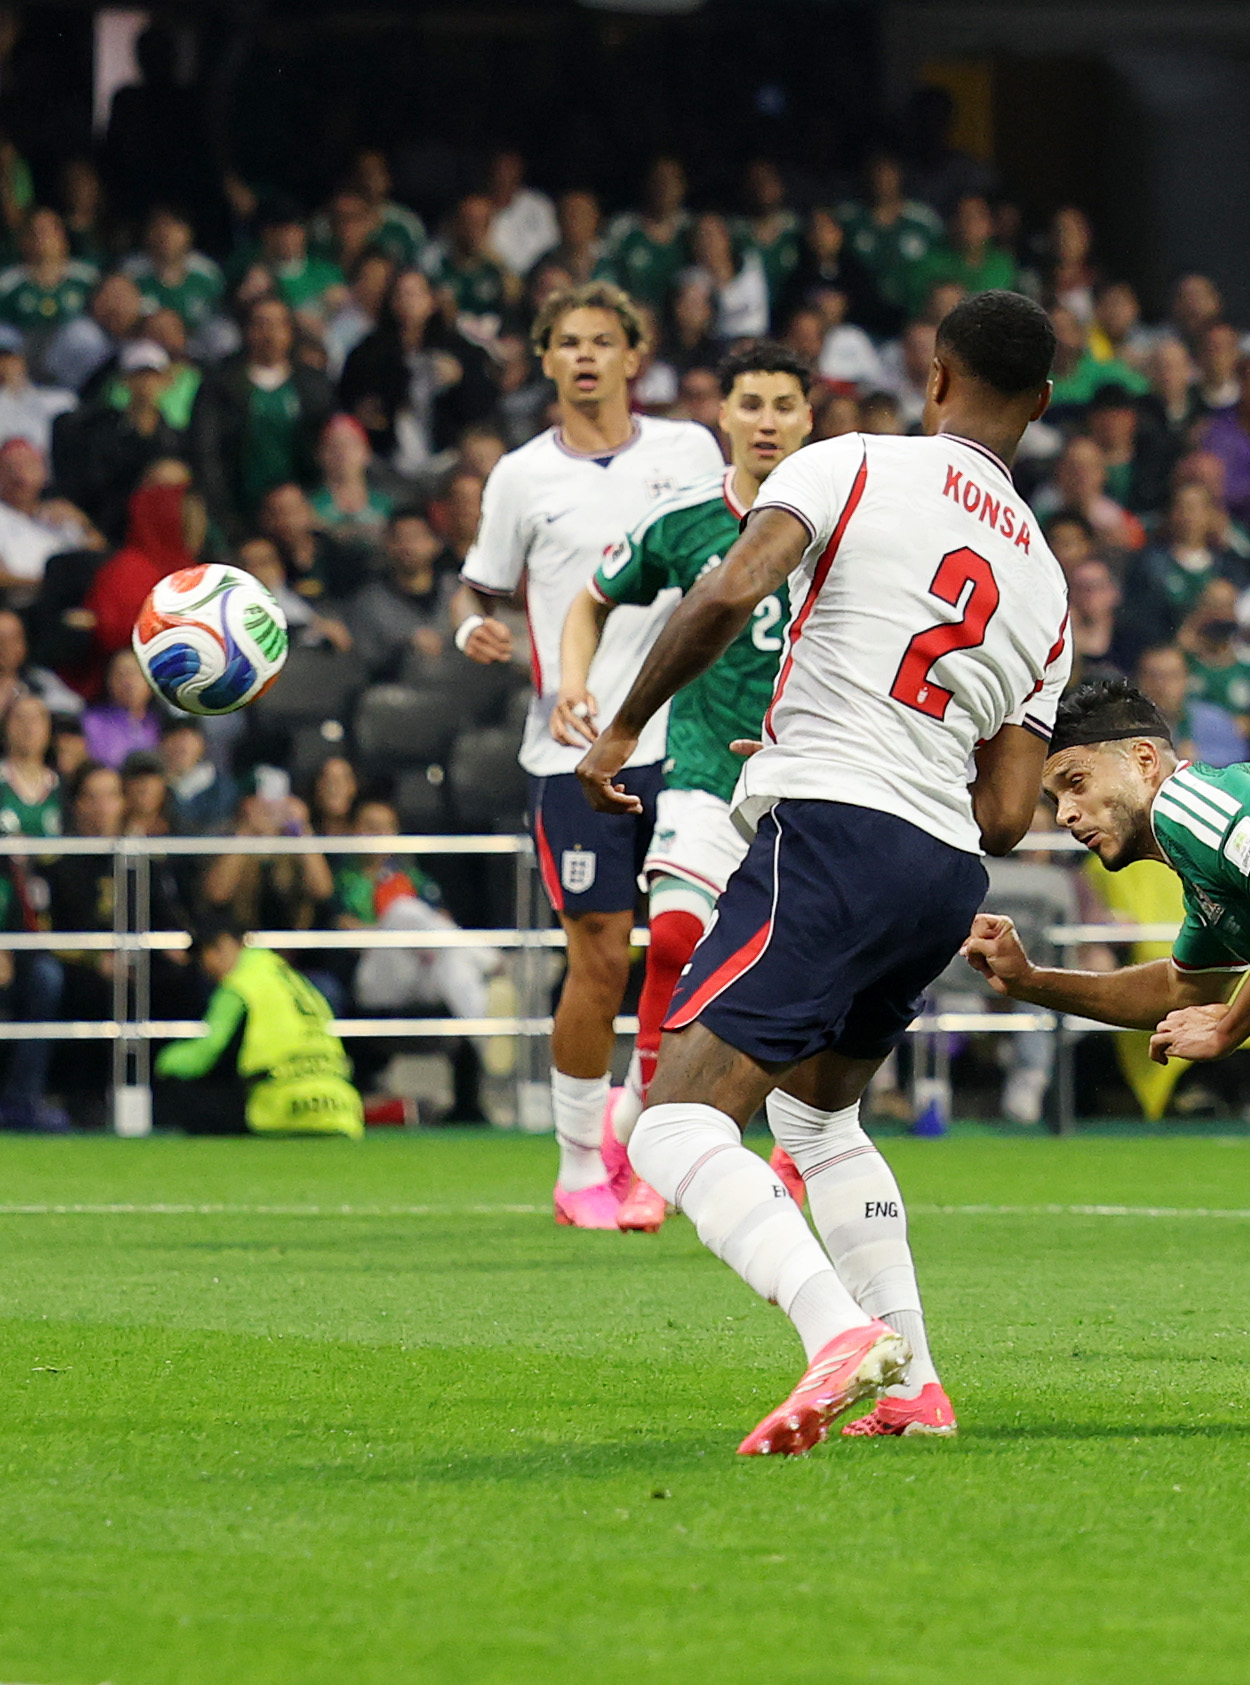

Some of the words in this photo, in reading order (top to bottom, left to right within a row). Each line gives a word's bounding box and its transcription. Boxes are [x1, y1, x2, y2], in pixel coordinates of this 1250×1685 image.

[943, 464, 1030, 555] KONSA
[752, 594, 781, 651] 2
[889, 545, 999, 722] 2
[864, 1202, 898, 1219] ENG
